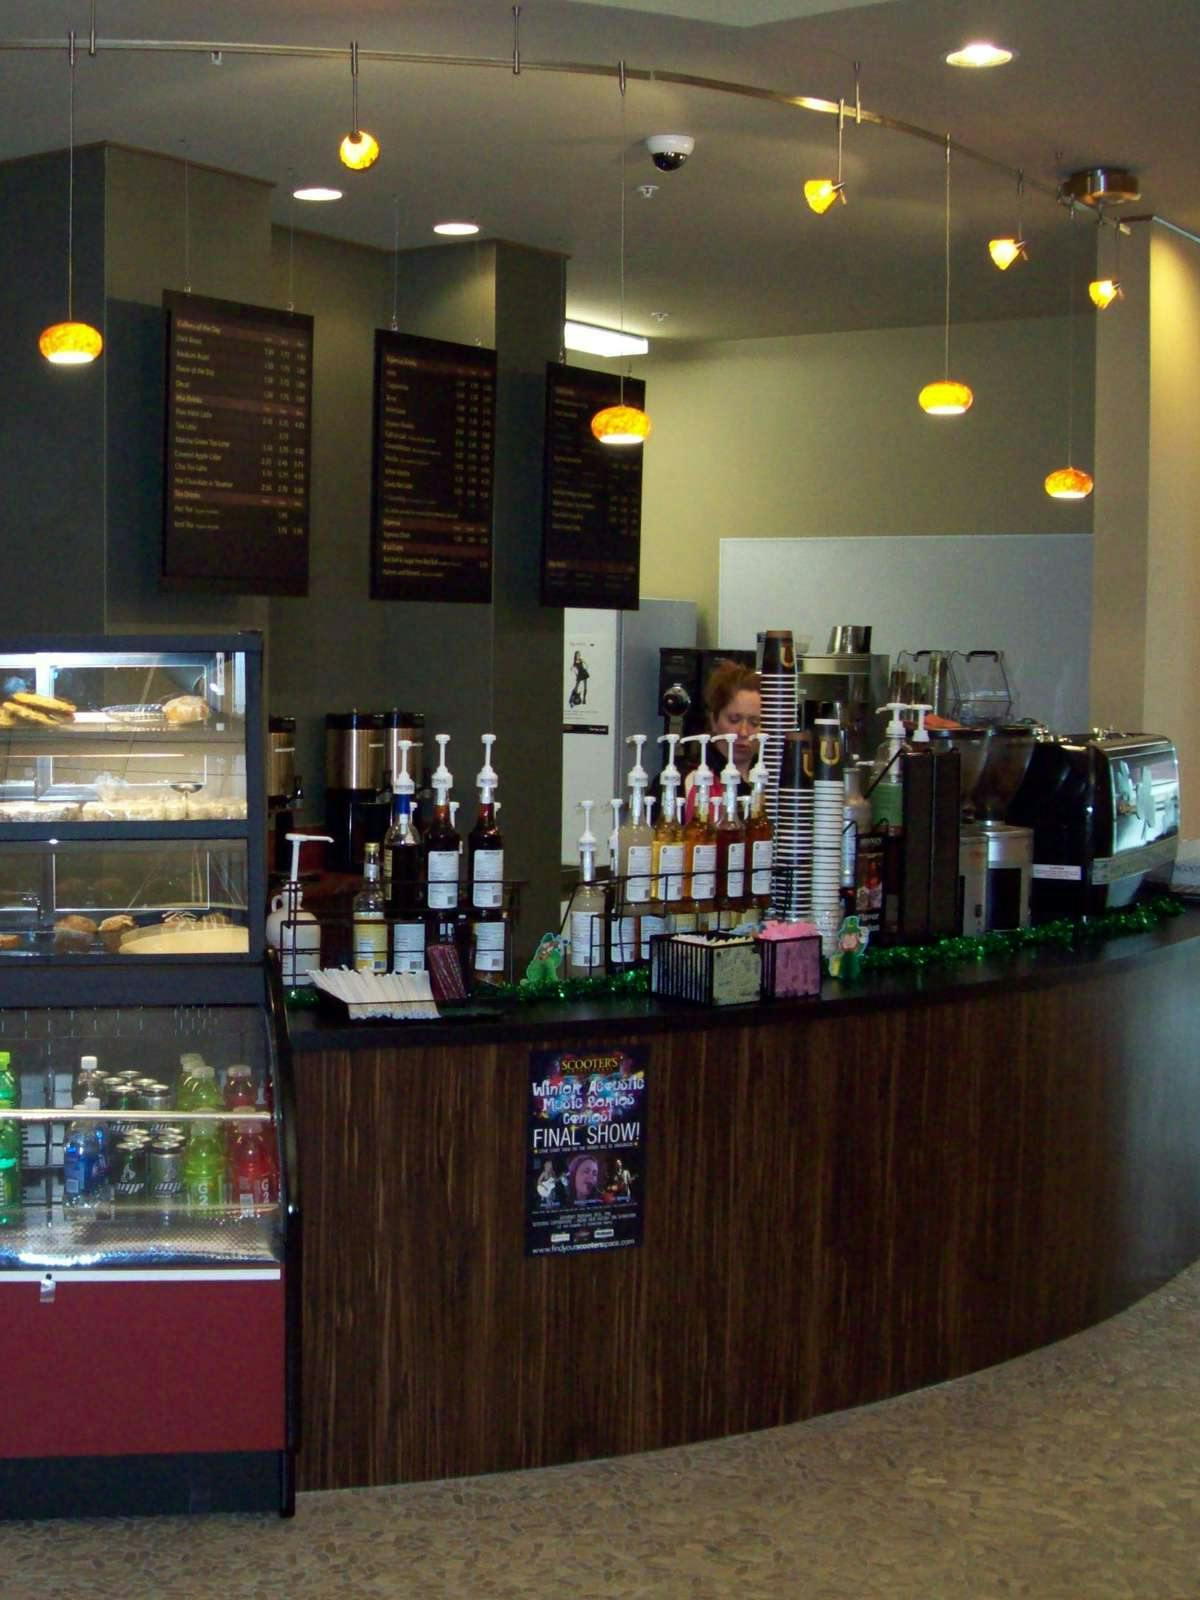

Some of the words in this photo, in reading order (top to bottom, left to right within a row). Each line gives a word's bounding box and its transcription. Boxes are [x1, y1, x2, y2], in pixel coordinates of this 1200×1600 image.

[561, 1058, 619, 1071] SCOOTER'S
[533, 1127, 581, 1149] FINAL
[587, 1122, 641, 1146] SHOW!
